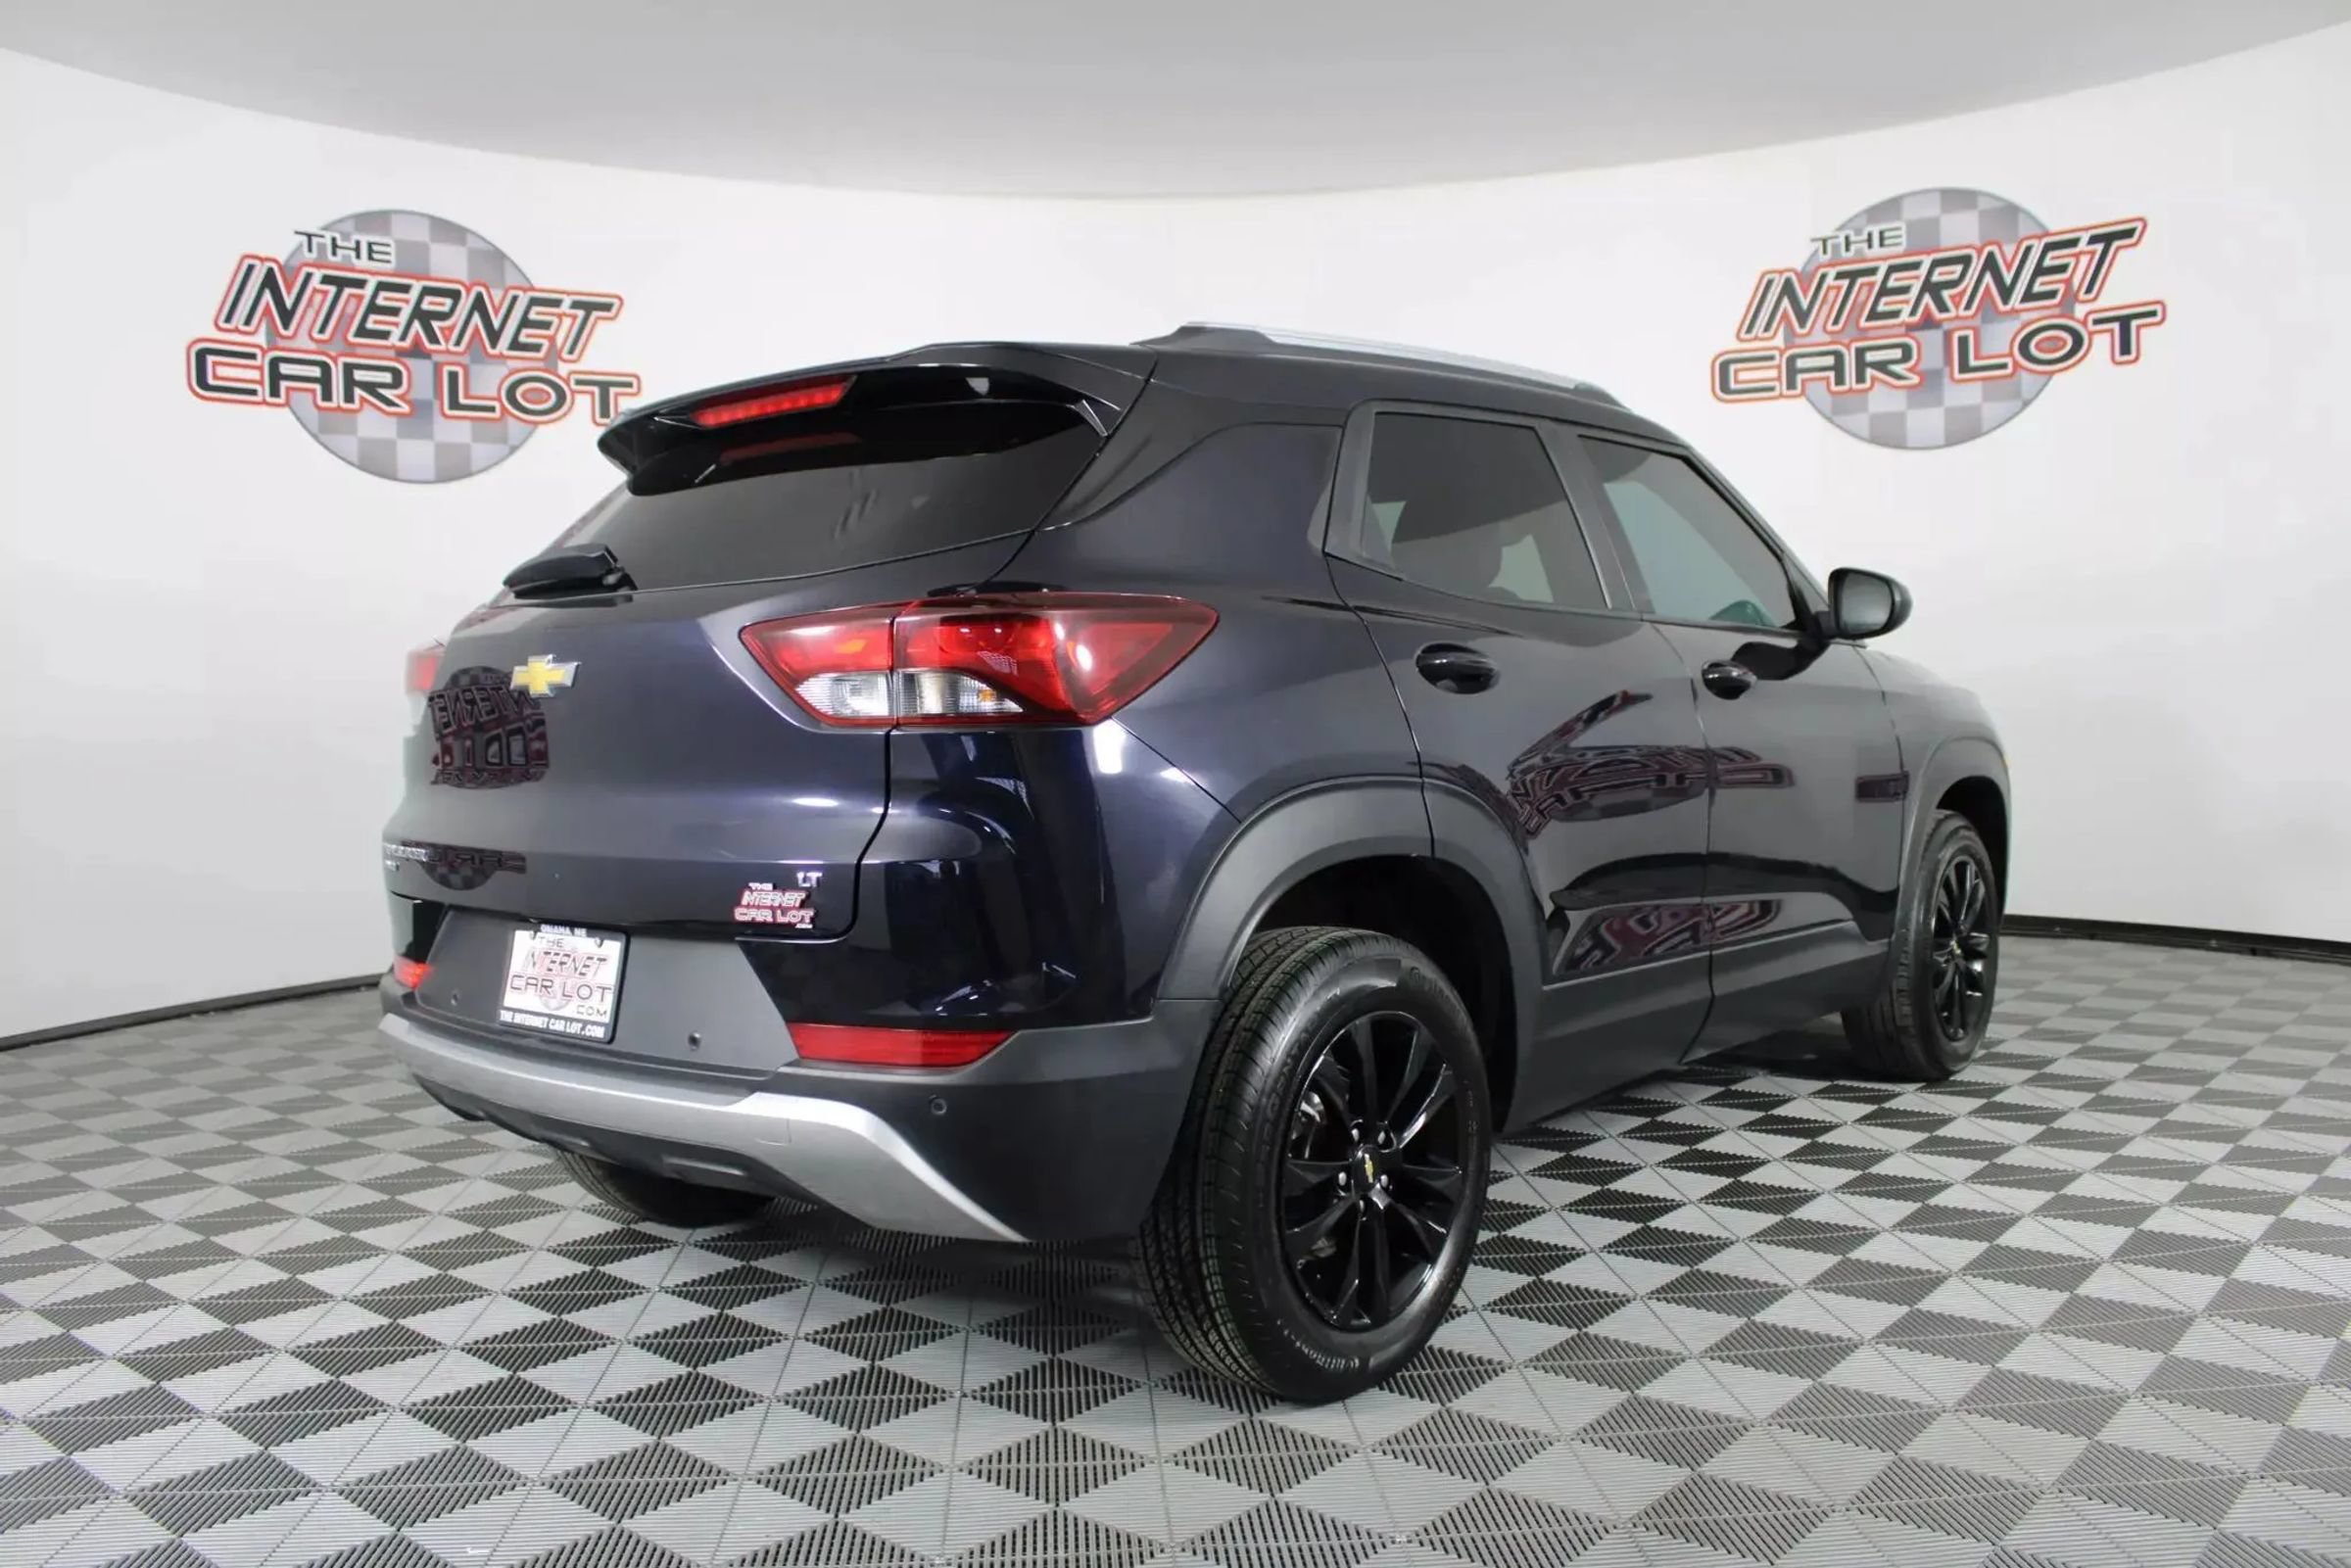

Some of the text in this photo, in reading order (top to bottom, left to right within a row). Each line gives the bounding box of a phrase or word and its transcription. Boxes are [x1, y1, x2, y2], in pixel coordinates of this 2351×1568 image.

[295, 231, 393, 264] THE
[1811, 226, 1904, 256] THE
[1740, 220, 2144, 339] INTERNET
[216, 257, 620, 359] INTERNET
[1713, 302, 2165, 401] CAR LOT
[188, 341, 639, 425] CAR LOT
[796, 872, 823, 887] LT
[734, 908, 814, 924] CAR LOT
[539, 936, 564, 948] THE
[522, 948, 607, 976] INTERNET
[510, 974, 612, 1003] CAR LOT
[549, 1019, 565, 1031] CAR
